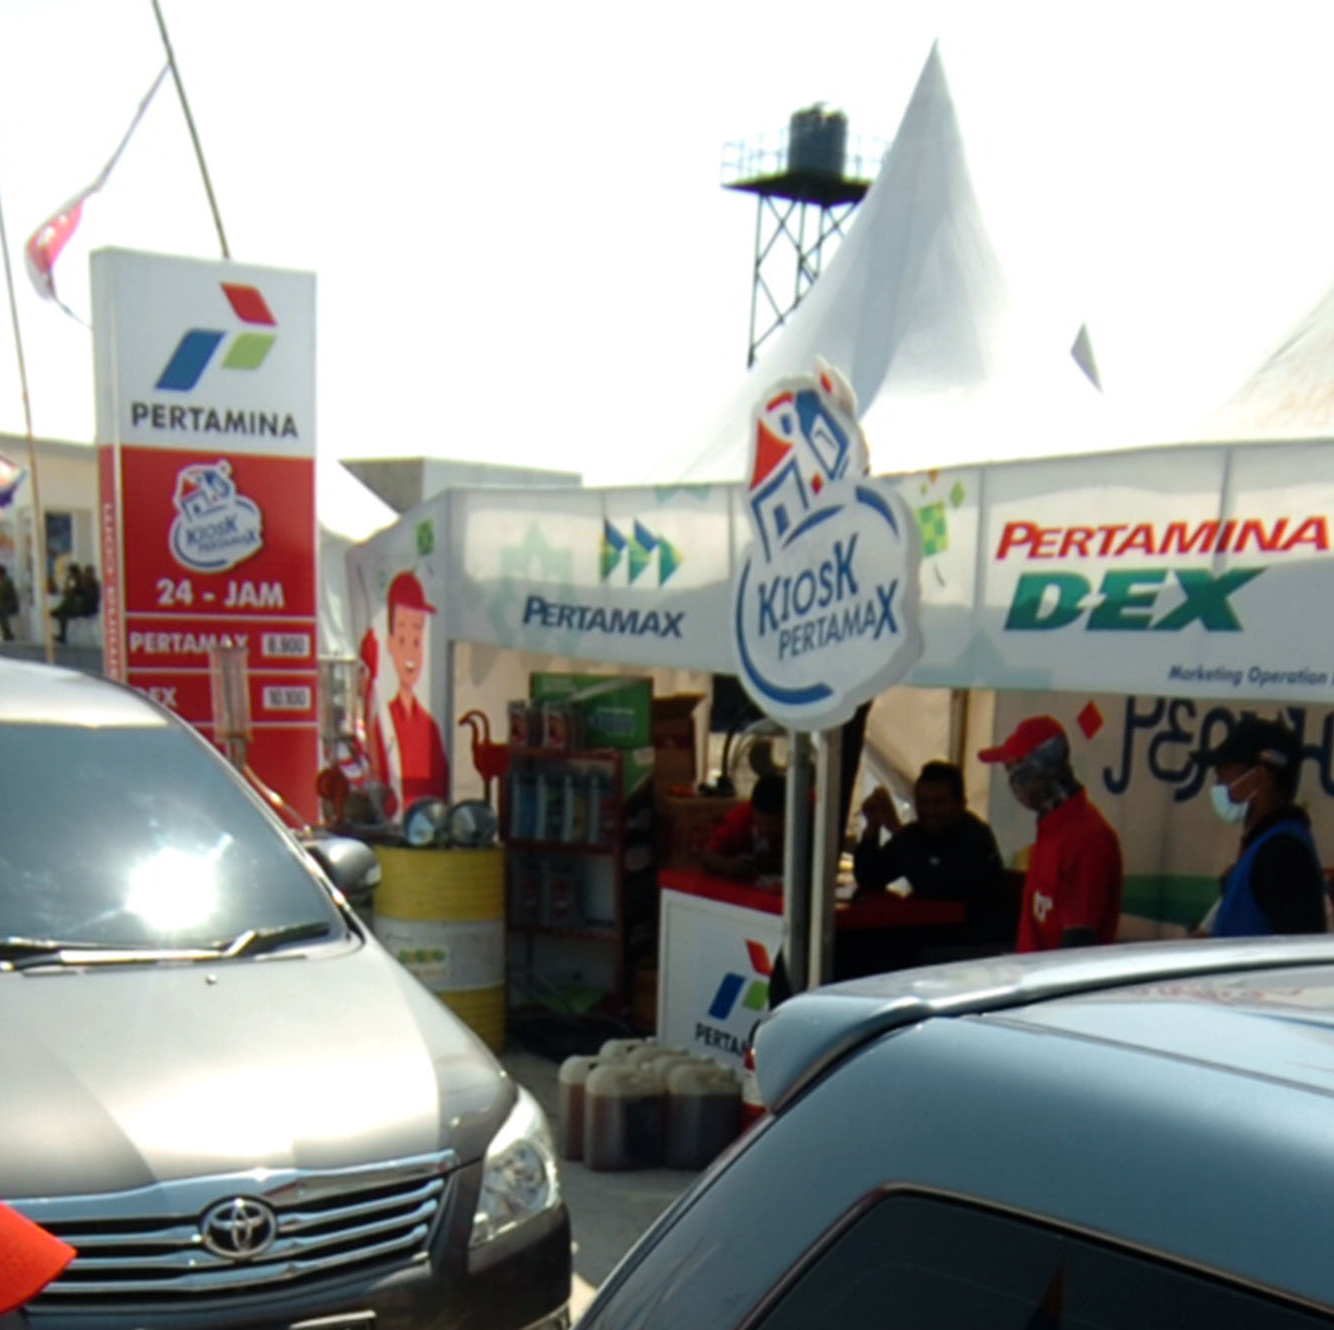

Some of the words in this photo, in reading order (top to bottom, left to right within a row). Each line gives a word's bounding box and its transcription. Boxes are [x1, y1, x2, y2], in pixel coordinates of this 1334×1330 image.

[131, 402, 299, 438] PERTAMINA
[996, 515, 1330, 560] PERTAMINA
[157, 577, 193, 606] 24
[203, 591, 215, 601] -
[224, 580, 285, 609] JAM
[758, 532, 858, 637] KIOSK
[1004, 567, 1268, 631] DEX
[523, 595, 685, 638] PERTAMAX
[778, 579, 898, 661] PERTAMAX
[1169, 665, 1244, 687] Marketing
[1247, 665, 1328, 688] Operation
